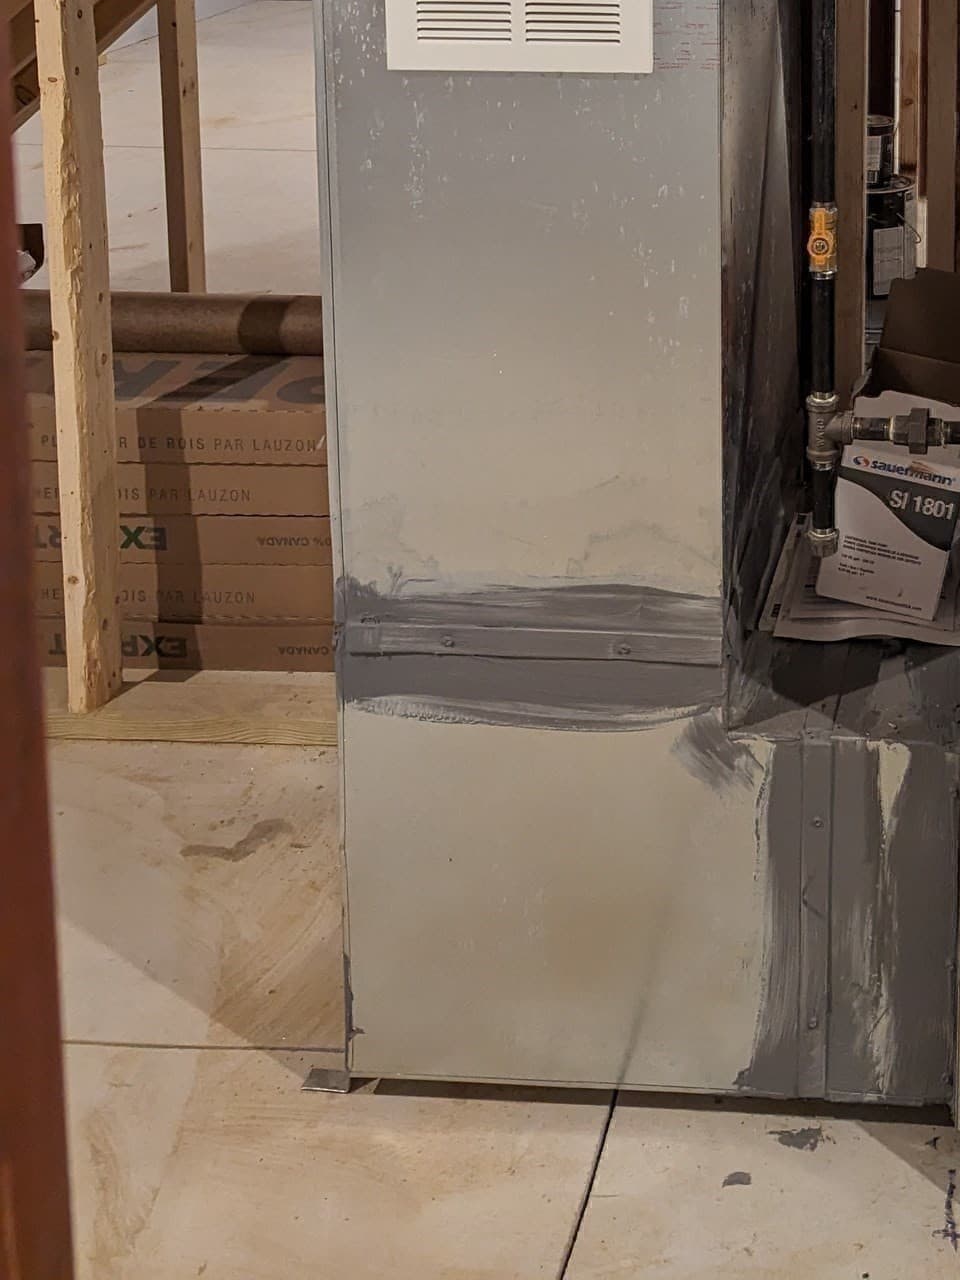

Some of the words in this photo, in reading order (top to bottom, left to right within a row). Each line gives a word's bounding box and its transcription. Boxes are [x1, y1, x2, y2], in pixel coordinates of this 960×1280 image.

[214, 438, 245, 451] PAR
[253, 438, 317, 452] LAUZON
[871, 459, 953, 486] sauermann
[150, 488, 179, 501] PAR
[188, 489, 251, 502] LAUZON
[913, 495, 954, 520] 1801
[257, 535, 310, 546] CANADA
[193, 591, 256, 605] LAUZON
[278, 645, 329, 656] CANADA
